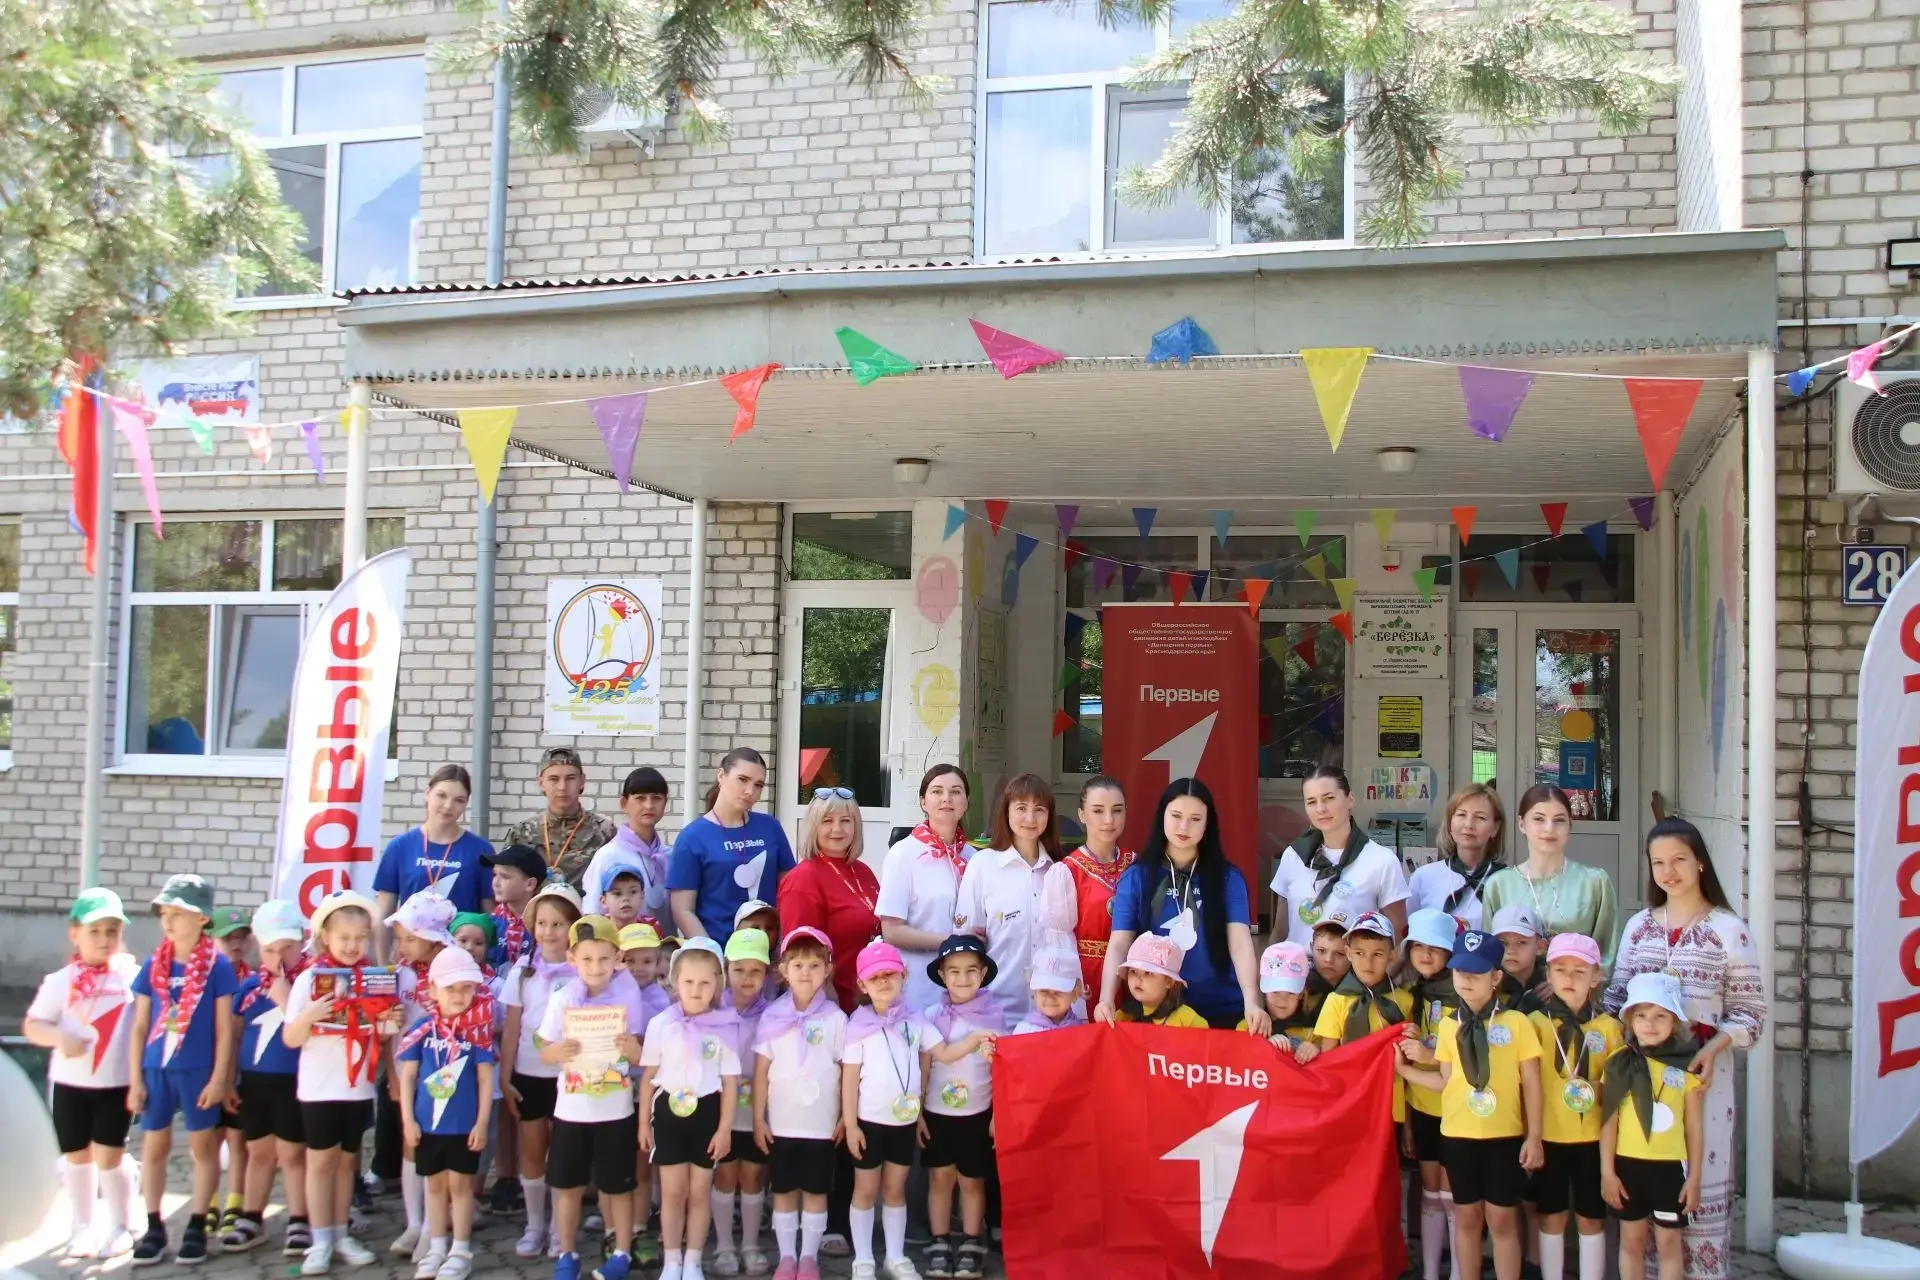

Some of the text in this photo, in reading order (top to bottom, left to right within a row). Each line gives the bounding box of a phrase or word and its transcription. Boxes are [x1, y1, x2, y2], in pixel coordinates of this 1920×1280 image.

[1848, 551, 1901, 600] 28
[569, 678, 633, 705] 125
[1140, 684, 1220, 707] Первые
[298, 606, 378, 936] ервые
[422, 1036, 472, 1052] Перые
[1147, 1052, 1269, 1090] Первые
